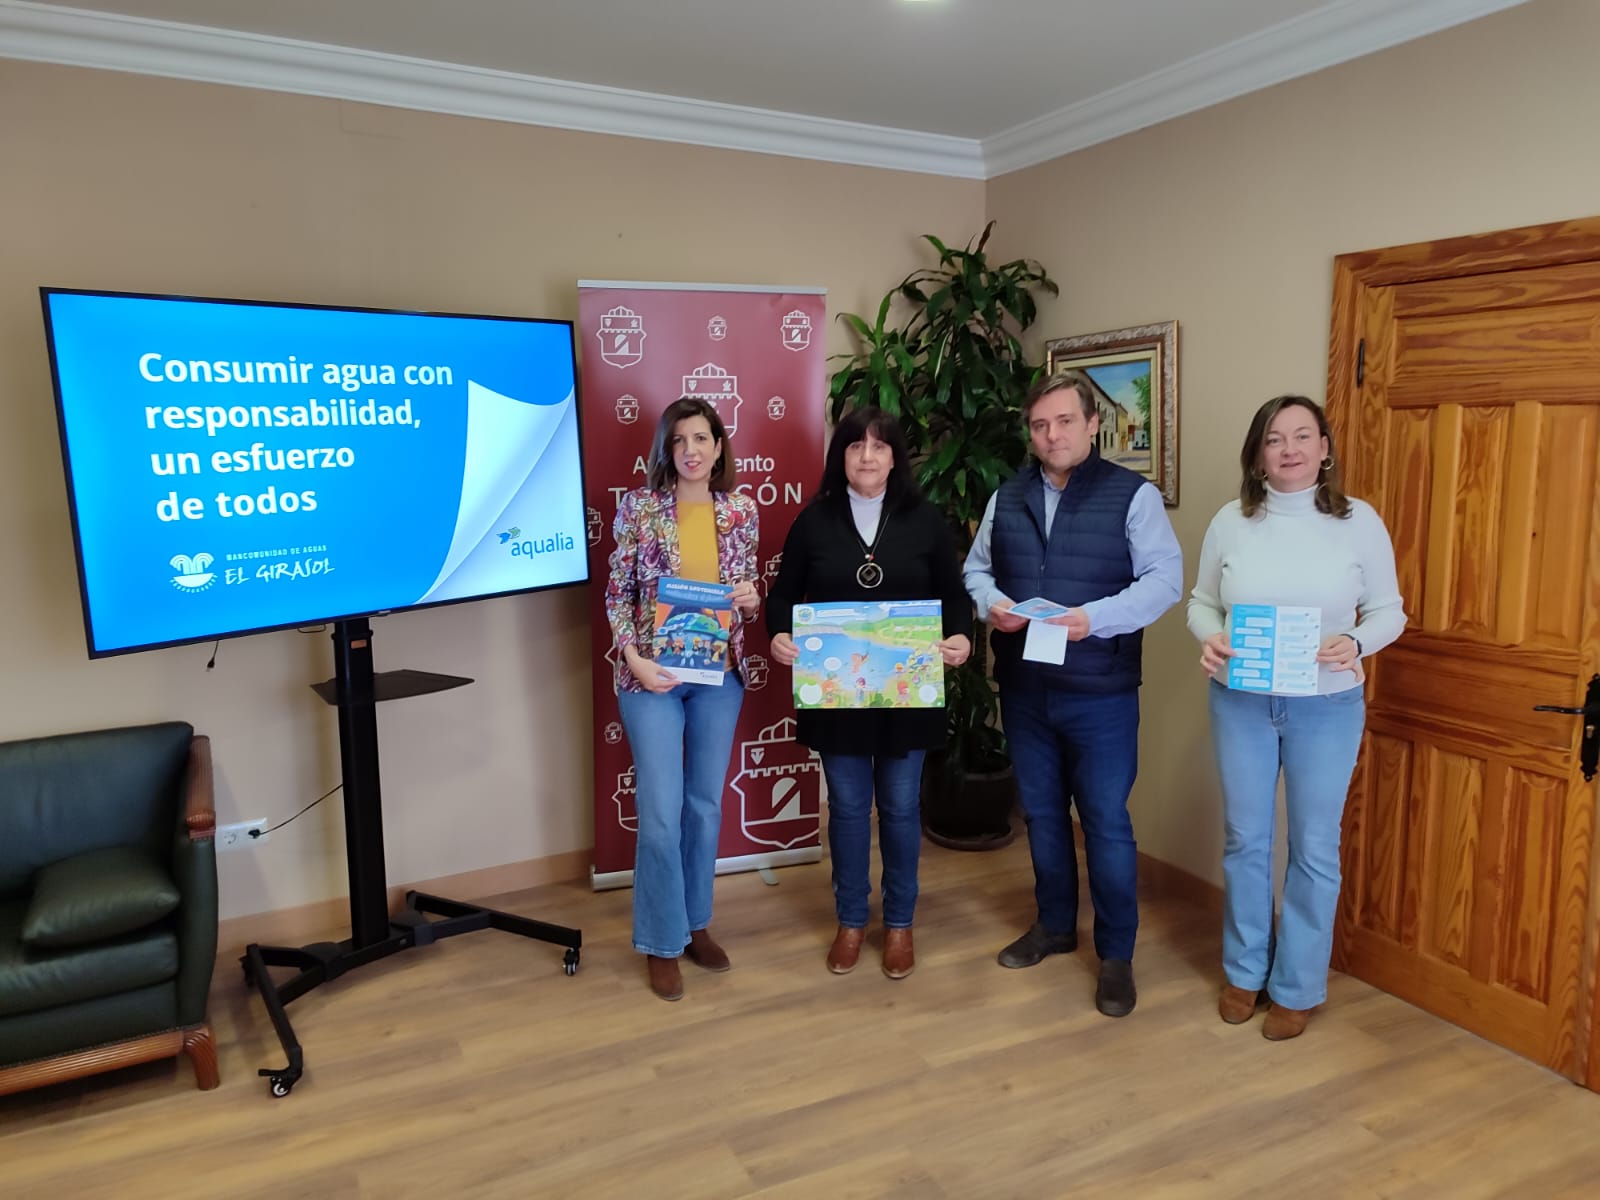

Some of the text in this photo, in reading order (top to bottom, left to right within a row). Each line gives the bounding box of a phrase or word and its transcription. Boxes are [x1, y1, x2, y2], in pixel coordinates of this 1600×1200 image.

[139, 352, 453, 392] Consumir agua con
[145, 398, 421, 437] responsabilidad,
[150, 442, 355, 476] un esfuerzo
[156, 485, 318, 522] de todos
[290, 547, 301, 555] DE
[302, 545, 327, 554] AGUAS
[511, 532, 574, 560] aqualia
[224, 558, 336, 585] EL GIRASOL
